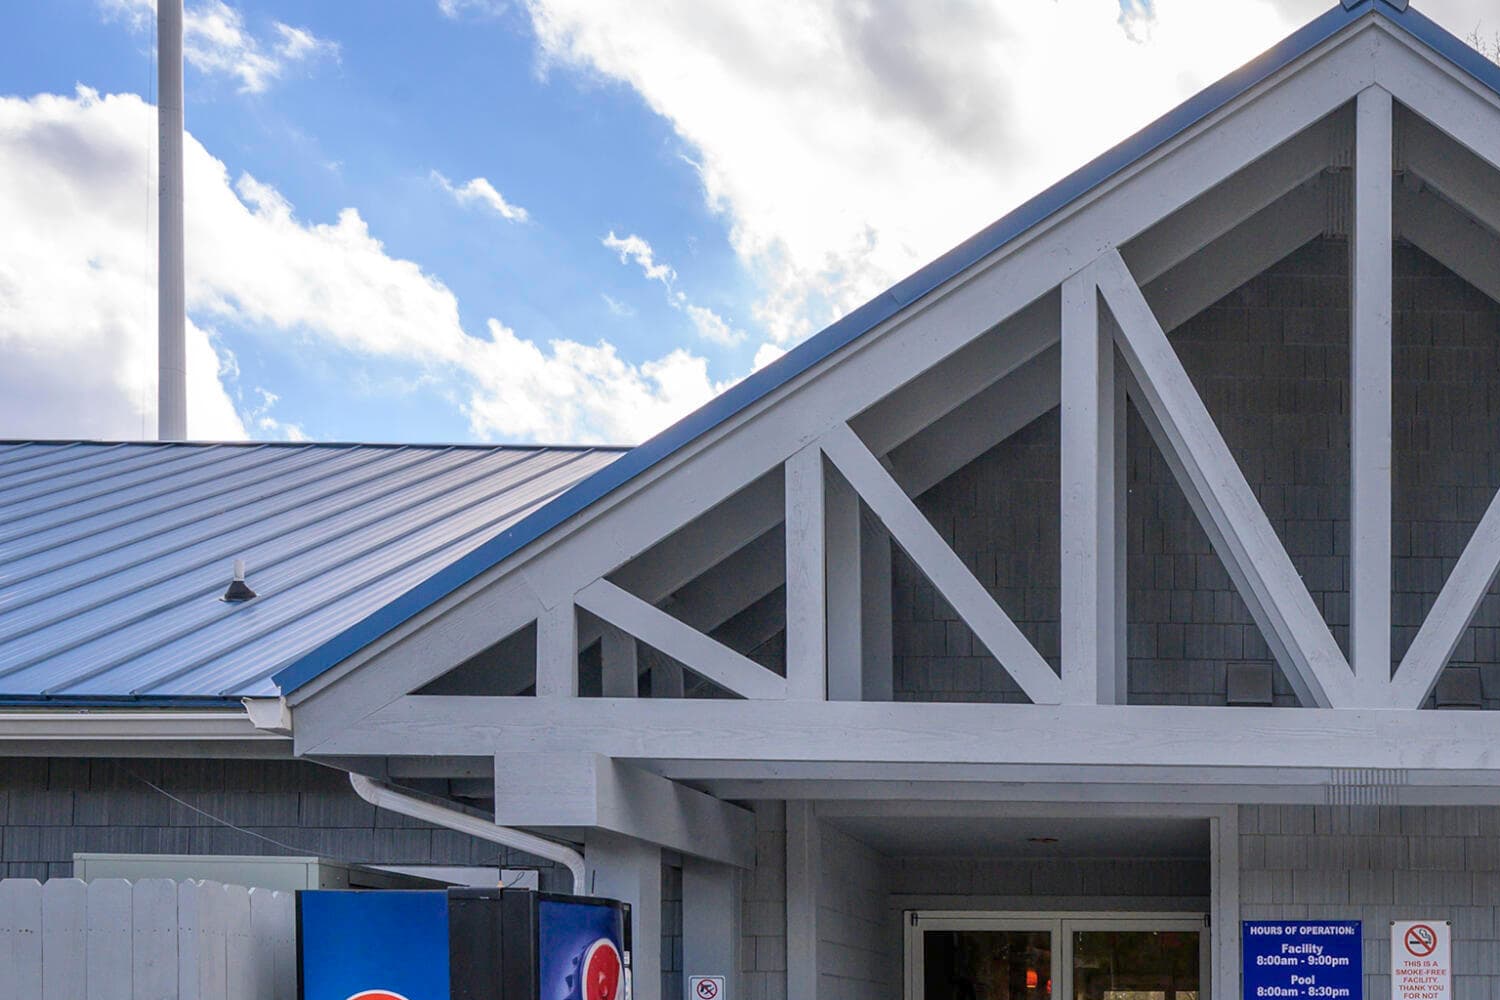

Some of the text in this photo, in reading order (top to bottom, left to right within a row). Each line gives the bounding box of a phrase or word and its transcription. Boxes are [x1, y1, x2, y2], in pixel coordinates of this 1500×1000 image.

[1250, 926, 1355, 936] HOURS OF OPERATION:
[1281, 943, 1323, 956] Facility
[1256, 956, 1298, 966] 8:00am
[1307, 956, 1349, 968] 9:00pm
[1291, 974, 1315, 986] Pool
[1256, 987, 1298, 997] 8:00am
[1308, 987, 1350, 999] 8:30pm
